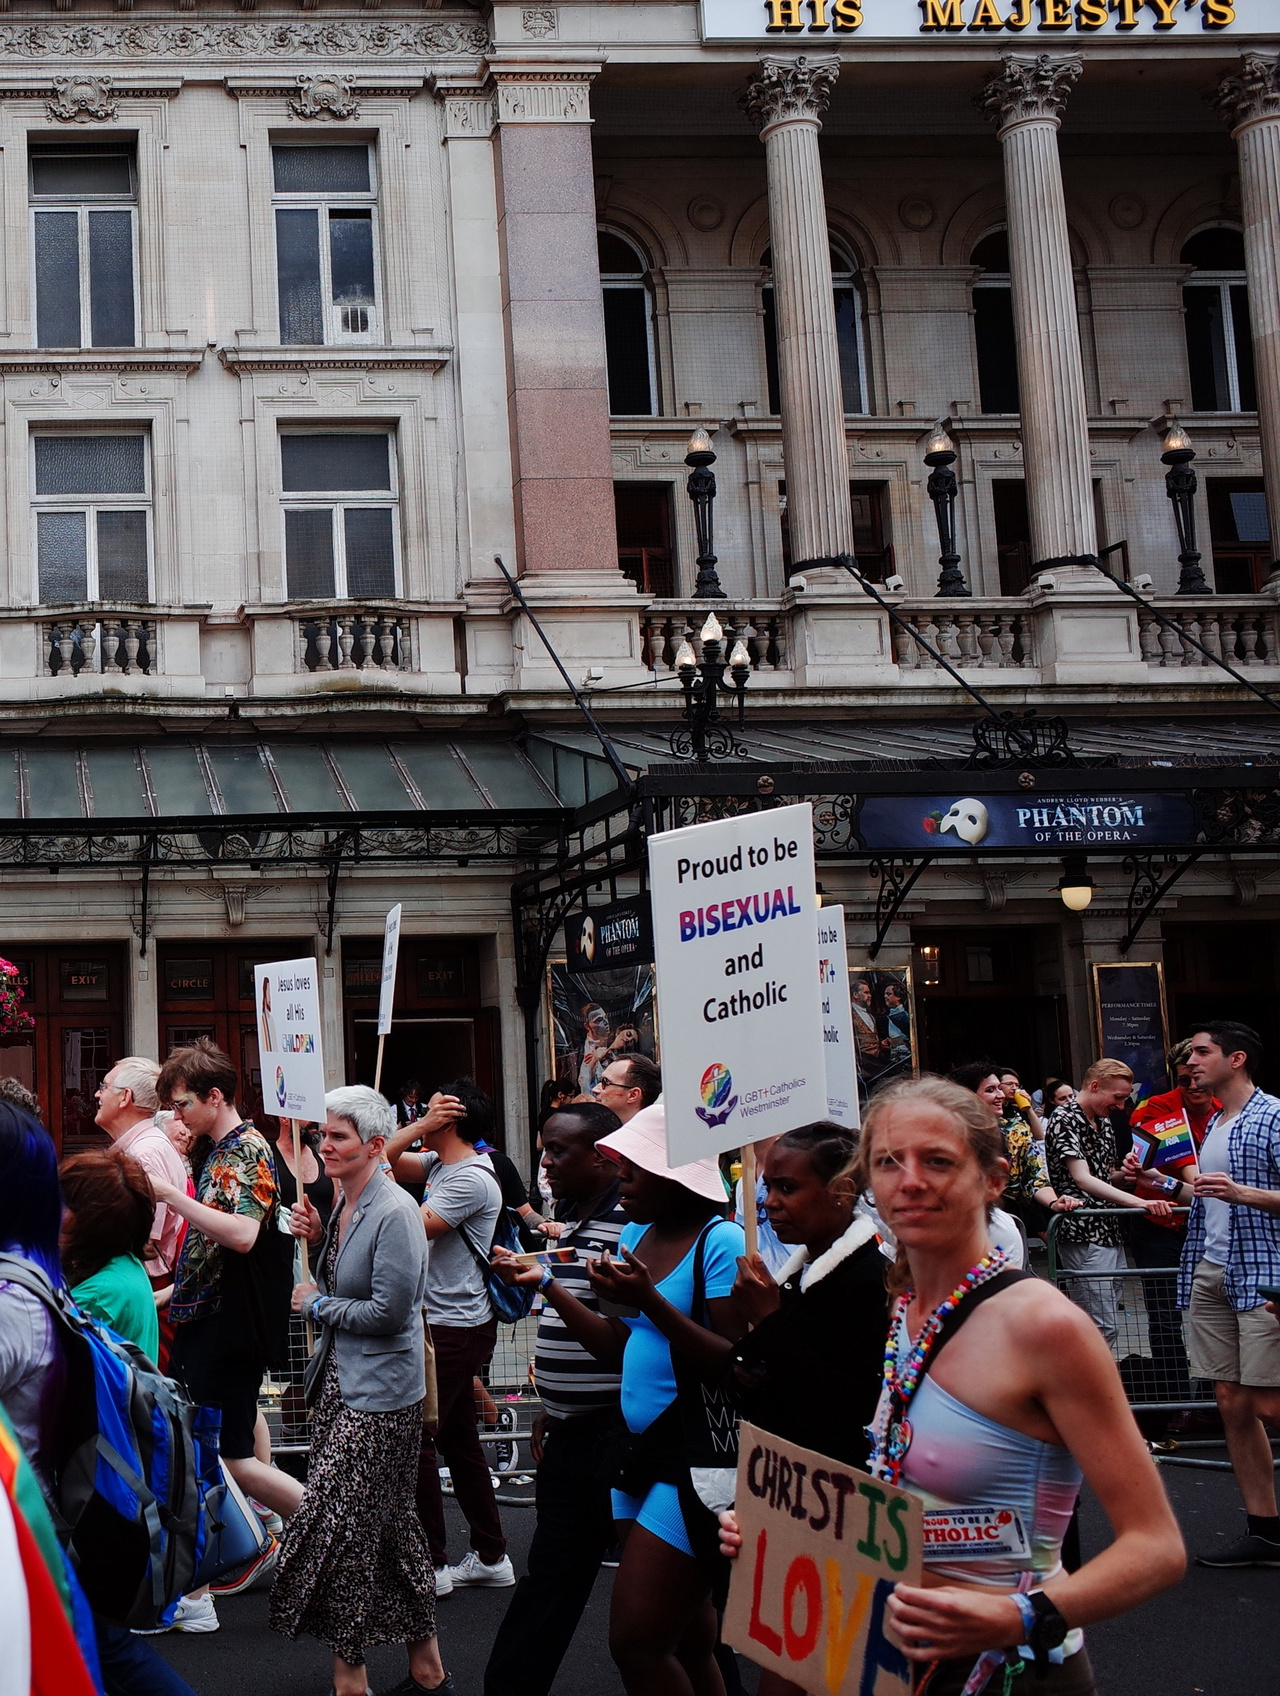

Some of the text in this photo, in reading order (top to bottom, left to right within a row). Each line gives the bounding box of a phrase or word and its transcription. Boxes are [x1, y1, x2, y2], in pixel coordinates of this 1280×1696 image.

[765, 0, 1236, 32] HIS MAJESTY'S
[1016, 804, 1146, 828] PHANTOM
[1035, 832, 1052, 842] OF
[1056, 831, 1083, 841] THE
[677, 837, 799, 885] Proud to be
[678, 886, 802, 943] BISEXUAL
[600, 916, 639, 944] PHANTOM
[724, 943, 764, 977] and
[71, 974, 98, 986] EXIT
[171, 978, 209, 989] CIRCLE
[277, 973, 311, 992] Jesus loves
[428, 971, 454, 980] EXIT
[286, 1004, 305, 1021] all His
[703, 980, 788, 1024] Catholic
[739, 1096, 790, 1118] Westminster
[746, 1444, 909, 1572] CHRIST IS
[951, 1516, 965, 1525] TO
[968, 1516, 980, 1525] BE
[984, 1515, 992, 1524] A
